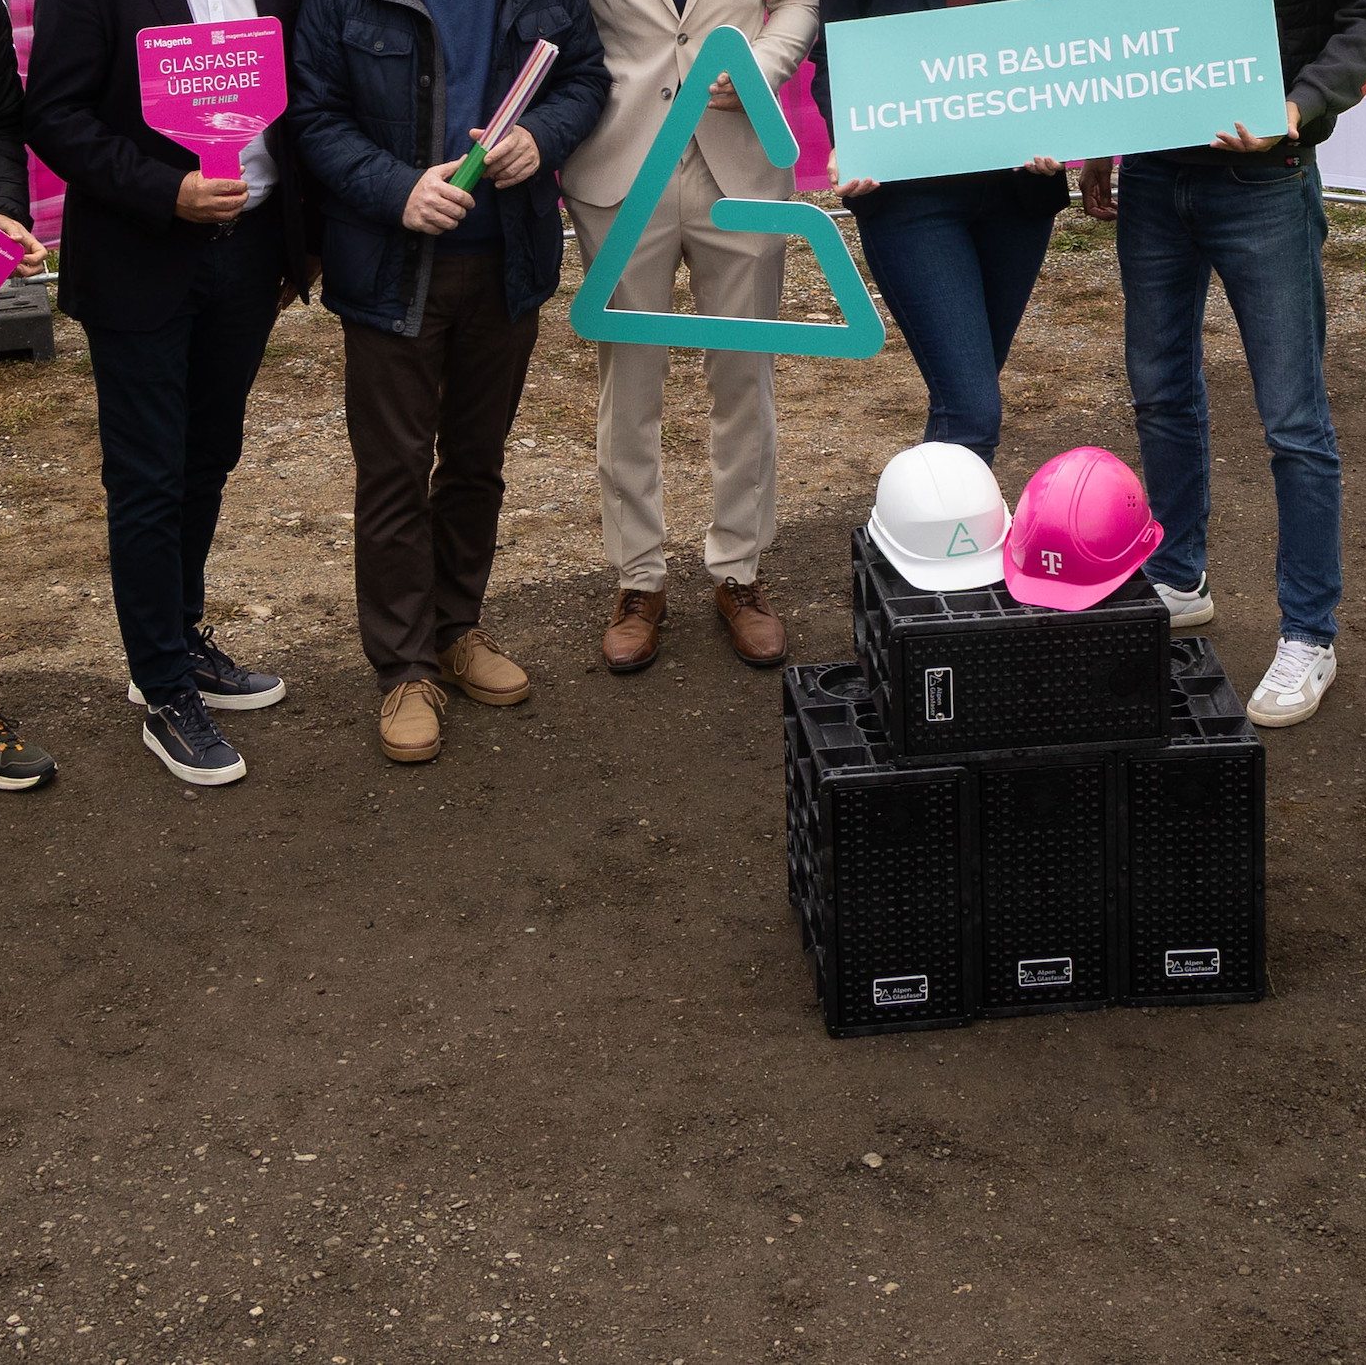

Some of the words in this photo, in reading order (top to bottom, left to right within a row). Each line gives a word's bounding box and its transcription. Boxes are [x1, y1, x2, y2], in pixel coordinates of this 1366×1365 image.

[153, 37, 192, 48] Magenta
[159, 50, 265, 74] GLASFASER-
[921, 53, 989, 84] WIR
[998, 36, 1112, 76] BAUEN
[1122, 27, 1180, 59] MIT
[167, 72, 260, 95] ÜBERGABE
[849, 57, 1264, 132] LICHTGESCHWINDIGKEIT.
[192, 96, 217, 106] BITTE
[218, 94, 238, 104] HIER
